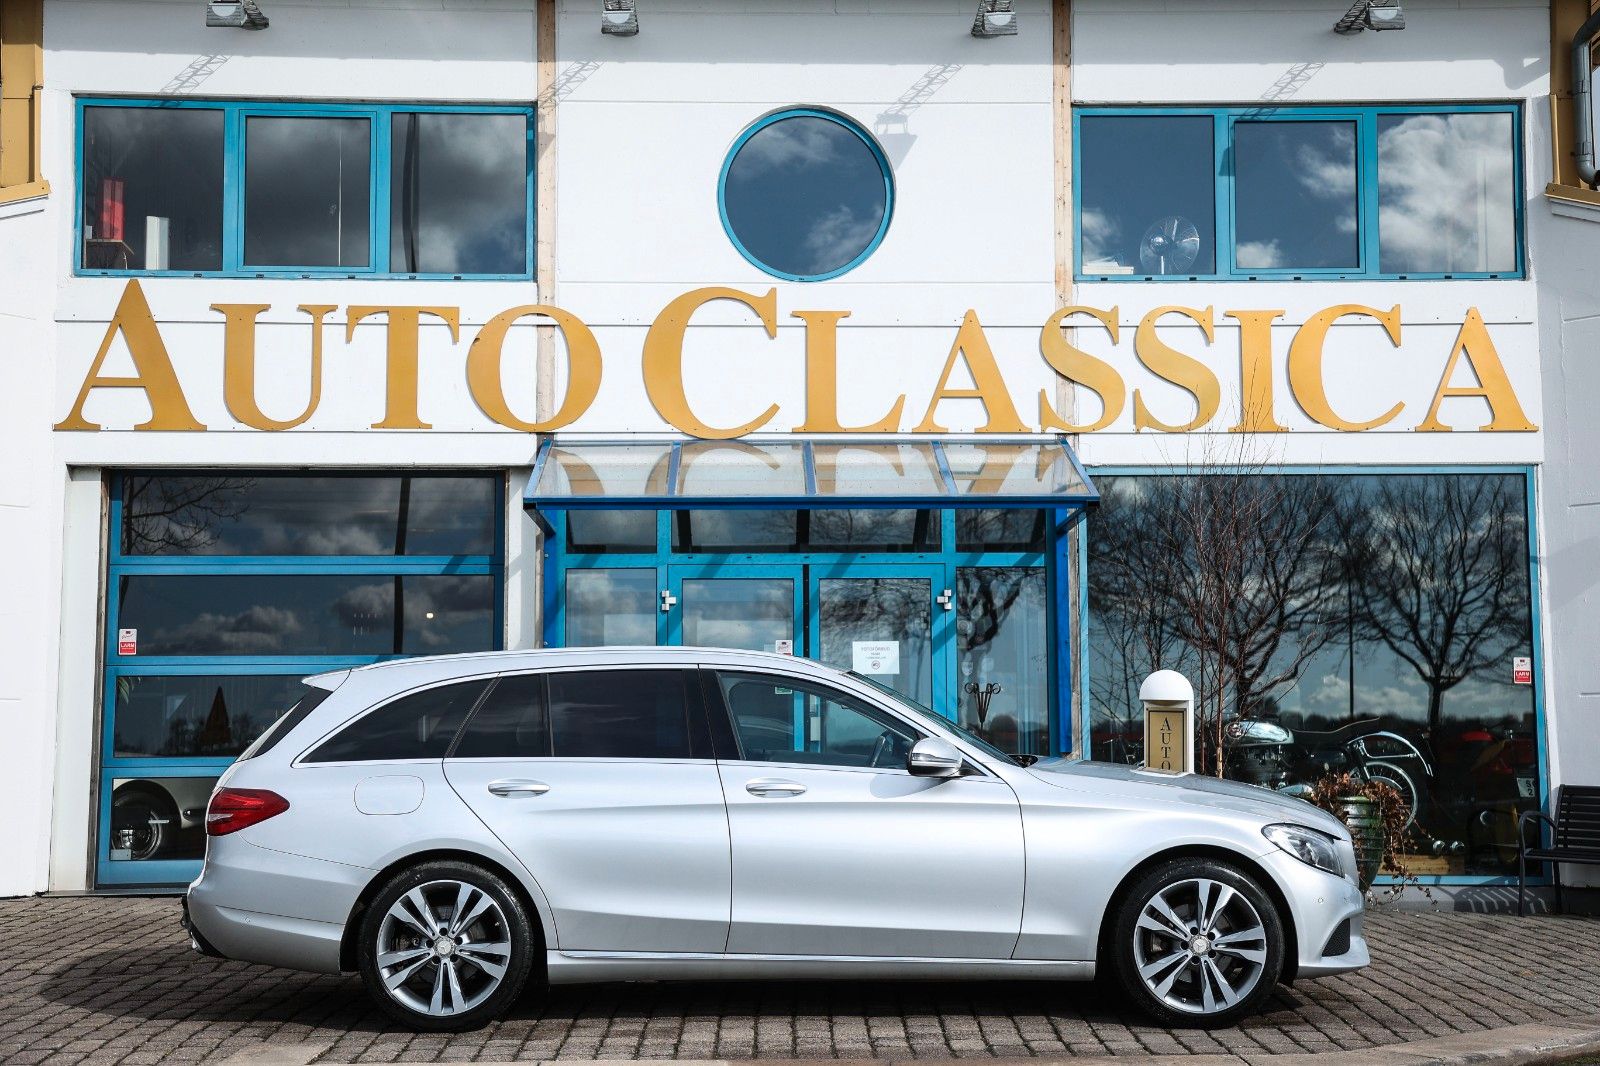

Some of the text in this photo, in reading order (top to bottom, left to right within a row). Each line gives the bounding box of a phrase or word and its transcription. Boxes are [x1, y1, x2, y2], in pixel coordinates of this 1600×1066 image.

[55, 279, 1538, 438] AUTO CLASSICA
[1160, 716, 1172, 771] AUTO
